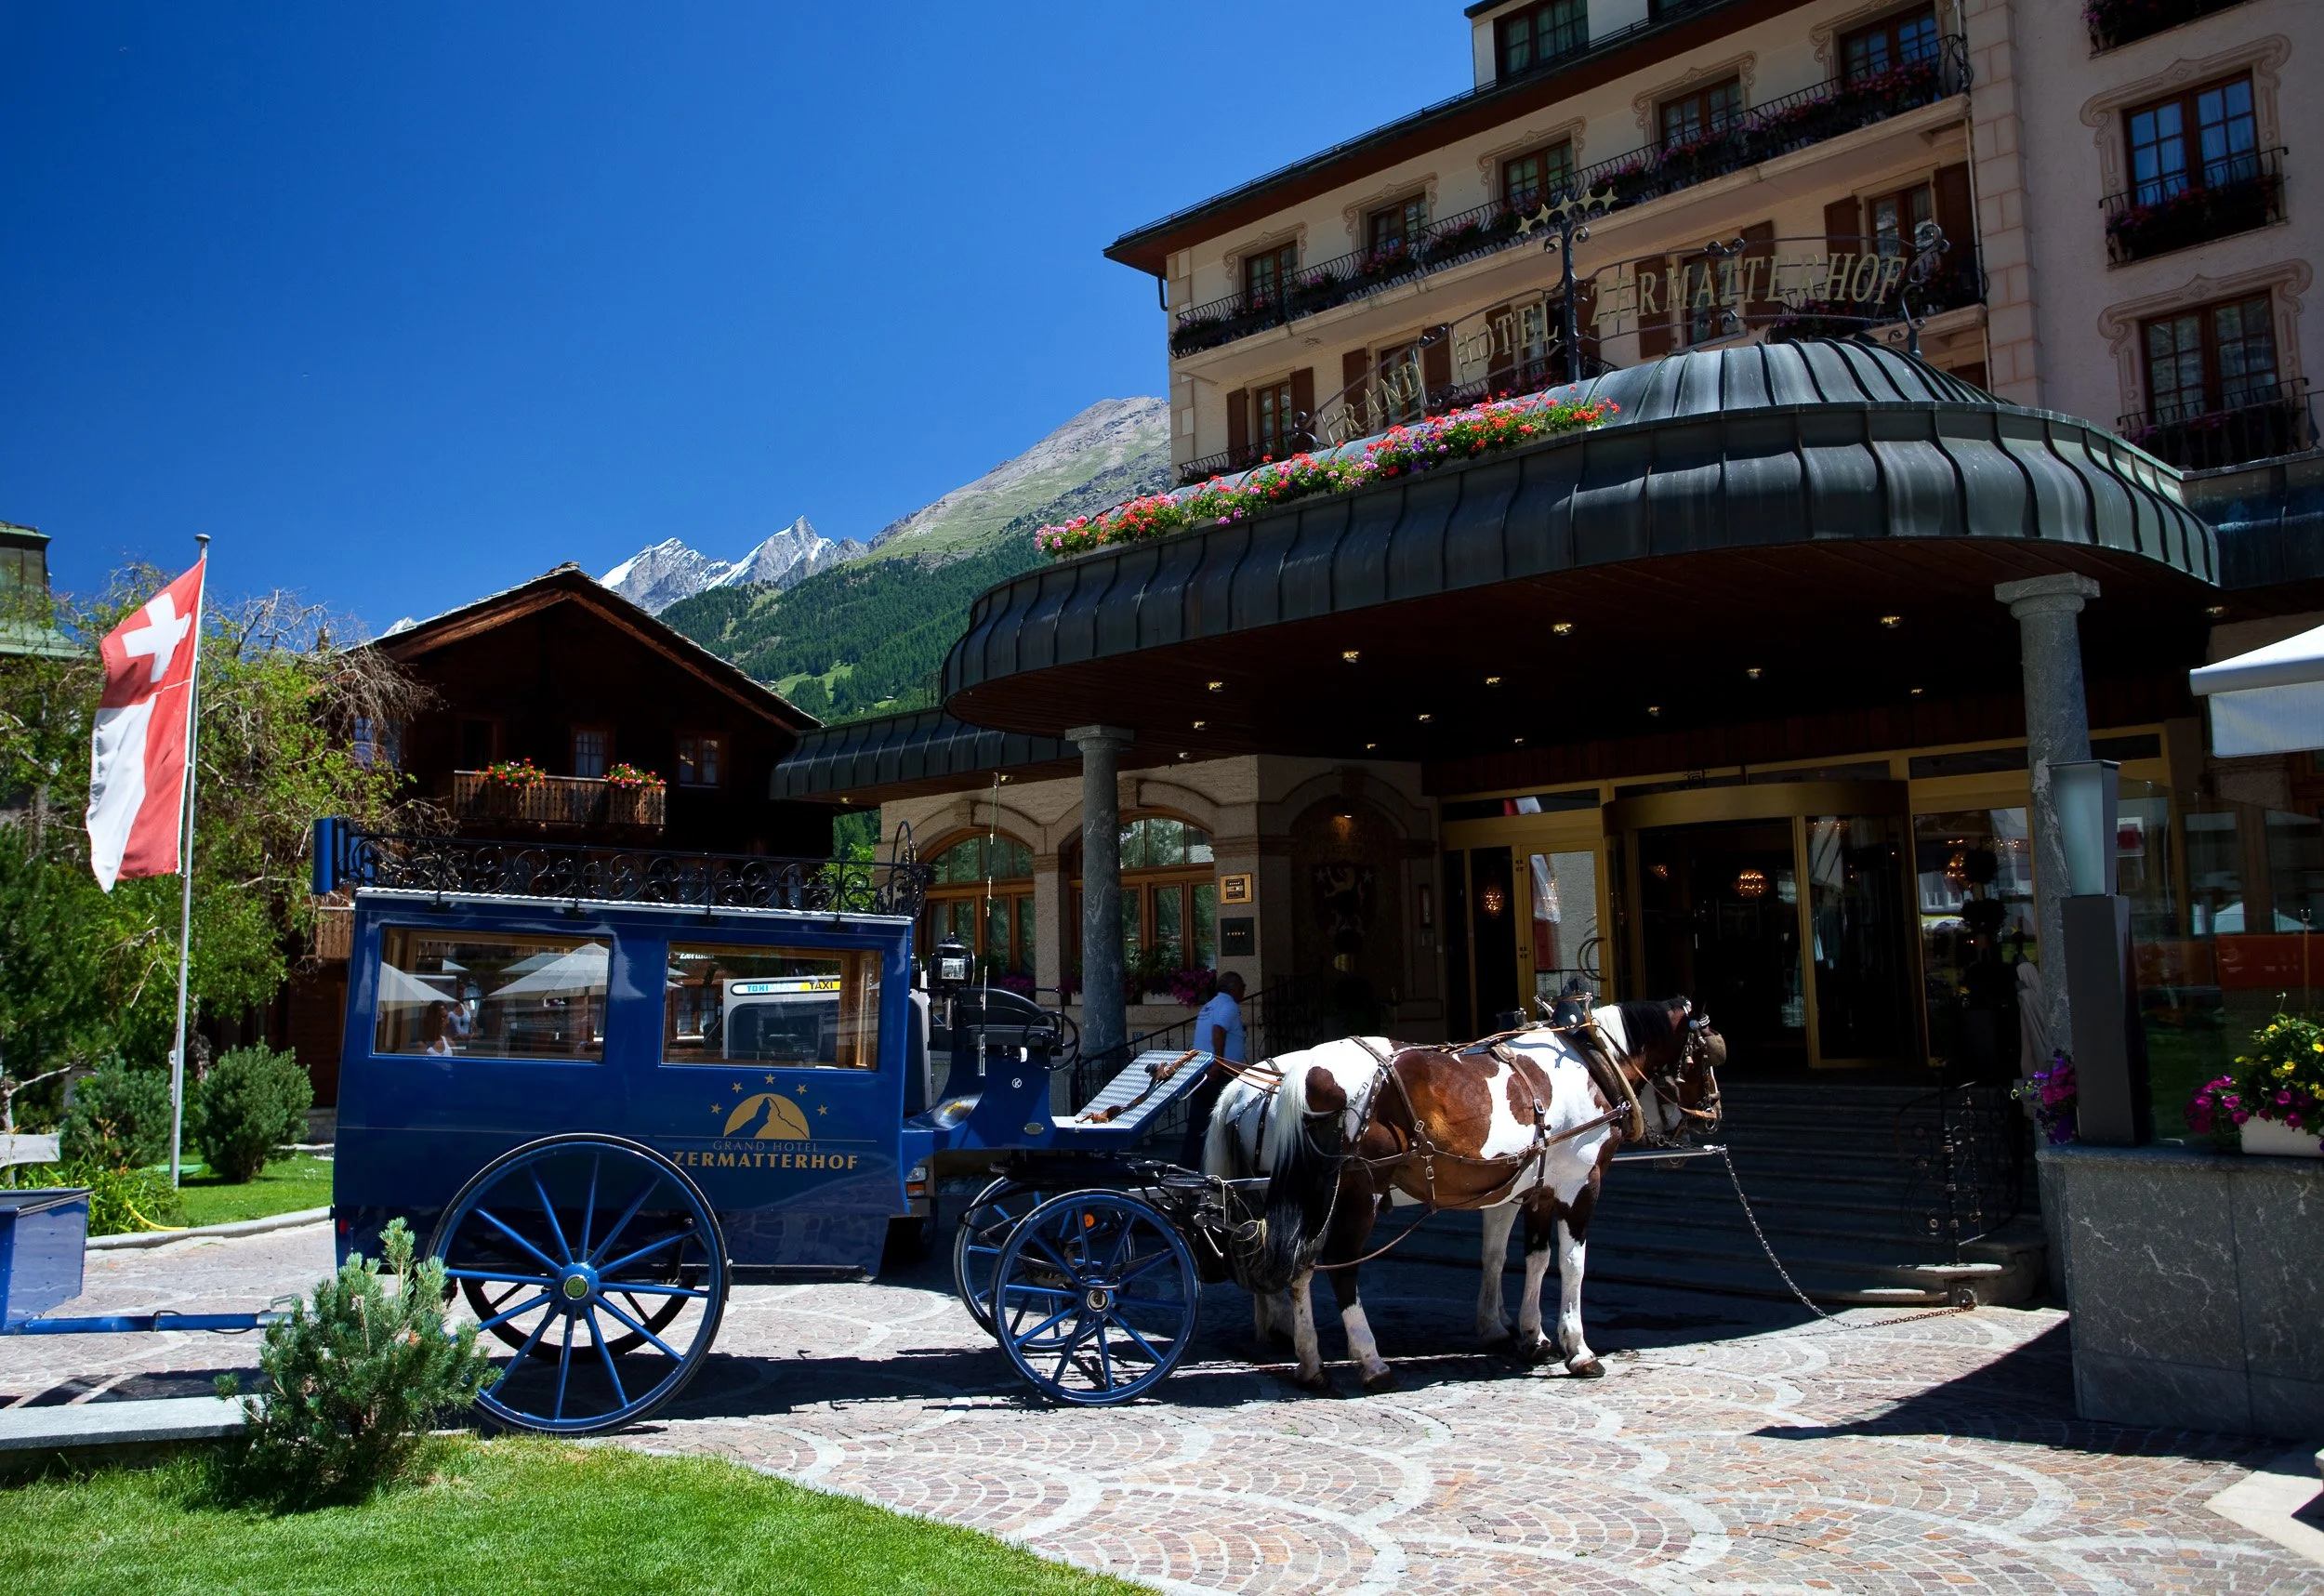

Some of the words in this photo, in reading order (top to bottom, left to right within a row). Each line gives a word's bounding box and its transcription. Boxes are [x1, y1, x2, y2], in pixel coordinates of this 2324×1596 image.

[1322, 362, 1422, 445] GRAND
[1455, 300, 1559, 376] HOTEL
[1590, 252, 1908, 326] ZERMATTERHOF
[809, 981, 834, 990] TAXI
[713, 1141, 766, 1151] GRAND
[772, 1141, 819, 1153] HOTEL
[672, 1151, 858, 1169] ZERMATTERHOF
